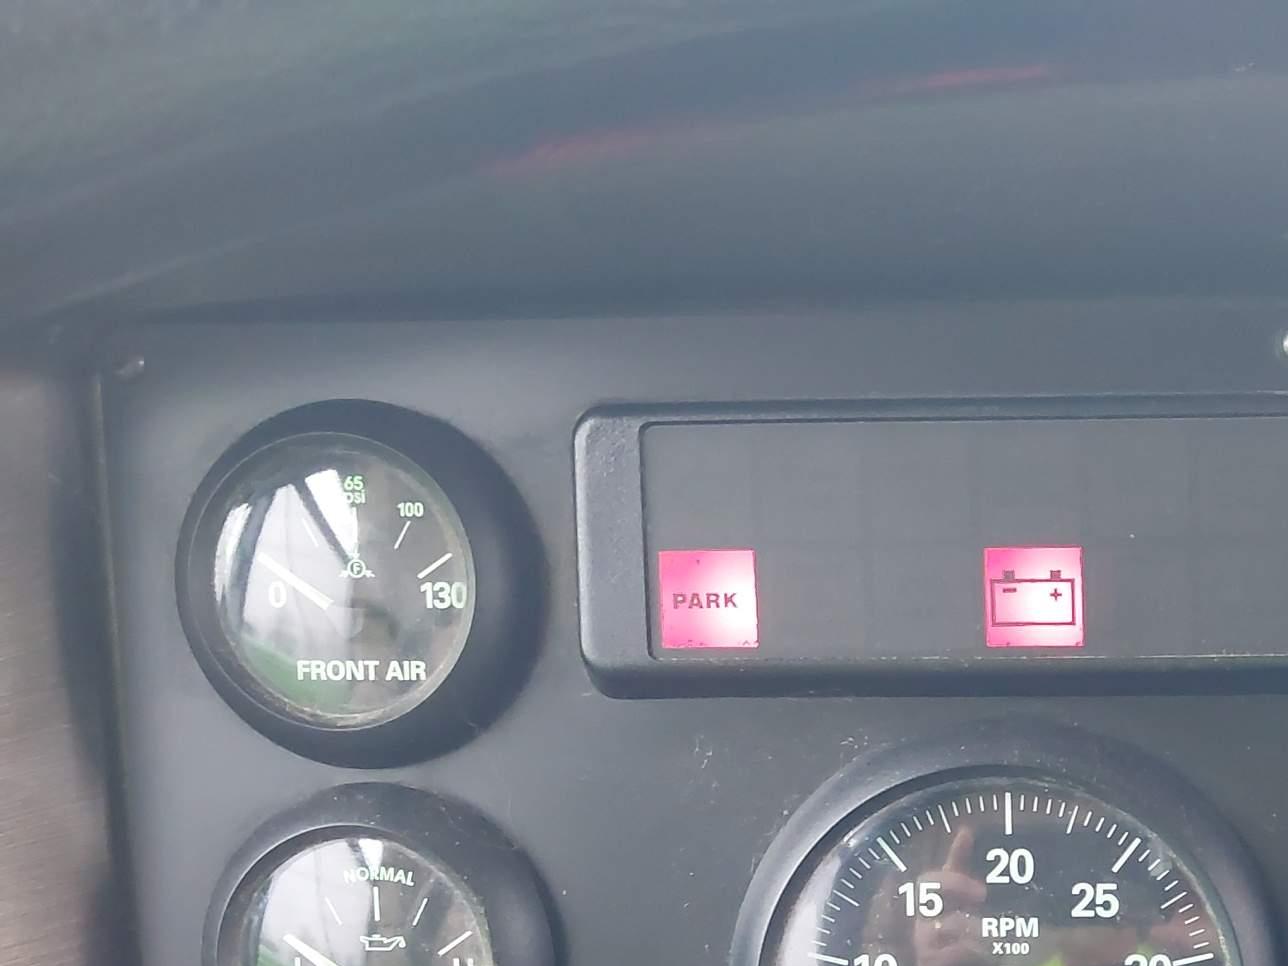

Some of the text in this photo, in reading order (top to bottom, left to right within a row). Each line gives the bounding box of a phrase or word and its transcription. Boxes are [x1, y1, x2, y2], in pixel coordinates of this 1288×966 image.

[343, 475, 365, 492] 65
[397, 502, 424, 517] 100
[268, 583, 287, 608] 0
[419, 581, 468, 609] 130
[671, 592, 739, 610] PARK
[296, 660, 427, 681] FRONT AIR
[343, 866, 415, 887] NORMAL
[985, 848, 1035, 884] 20
[897, 882, 944, 917] 15
[1070, 882, 1120, 918] 25
[981, 917, 1039, 939] RPM
[992, 942, 1030, 956] X100
